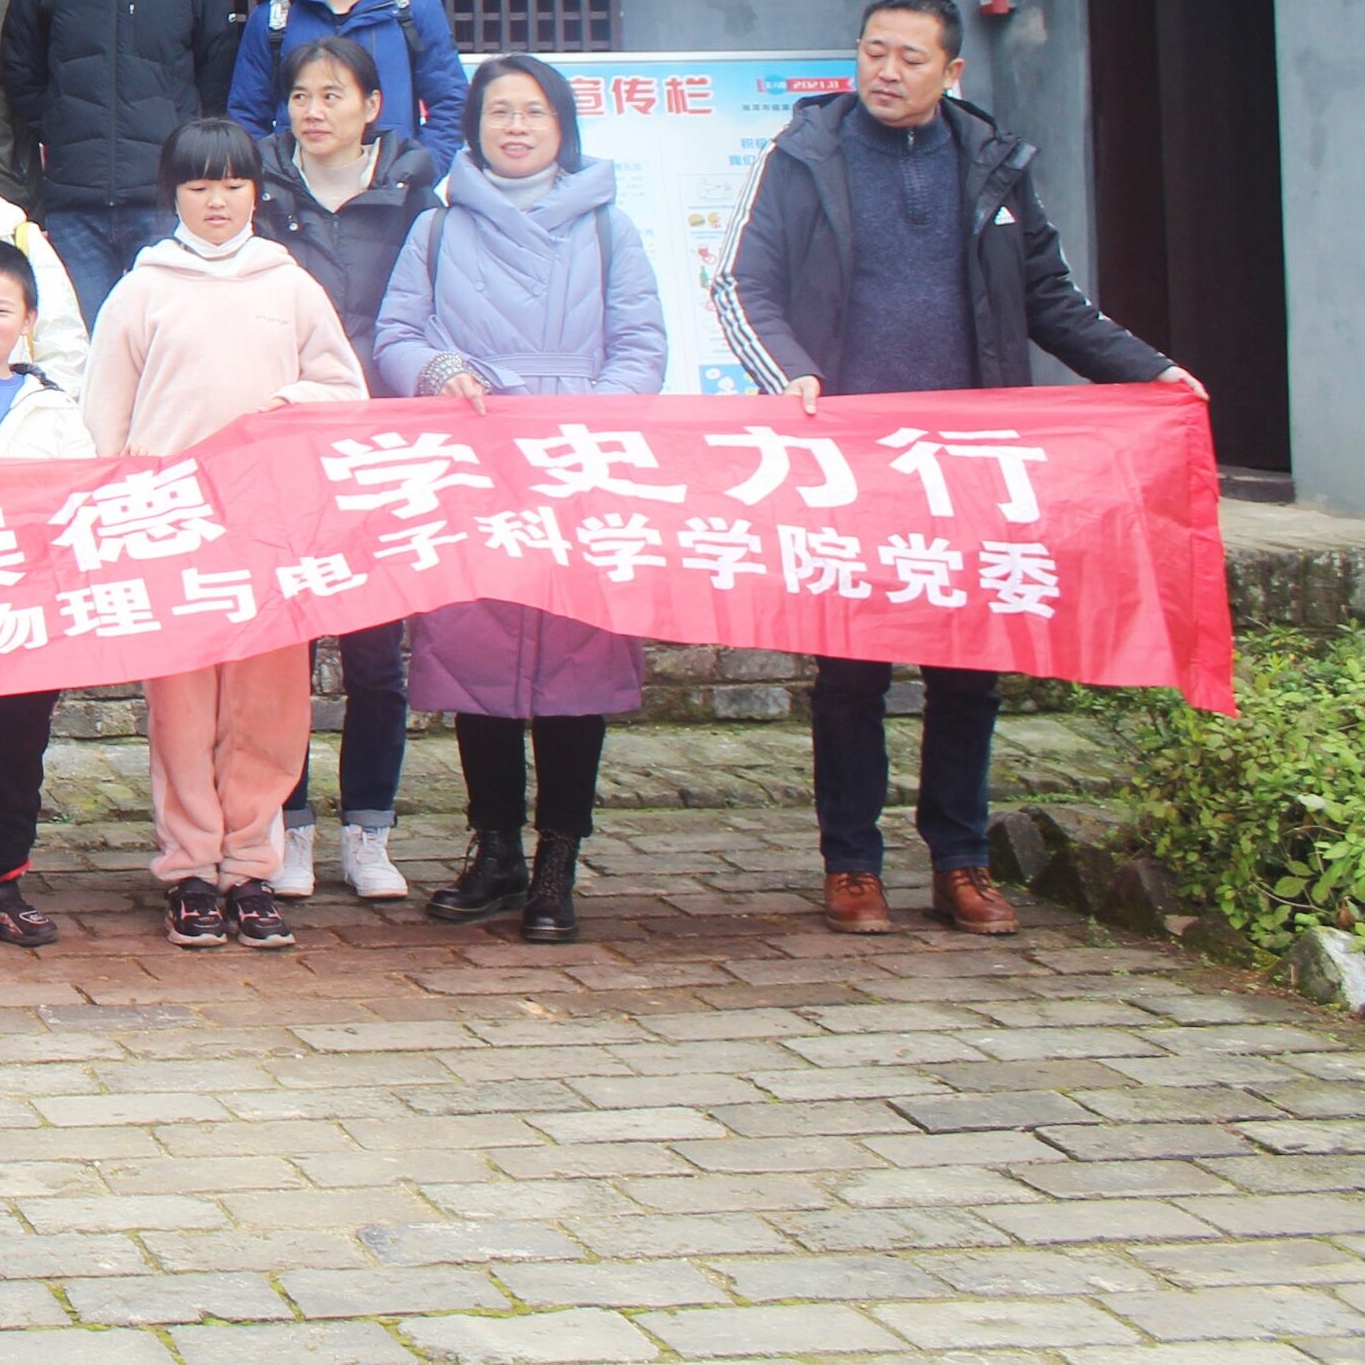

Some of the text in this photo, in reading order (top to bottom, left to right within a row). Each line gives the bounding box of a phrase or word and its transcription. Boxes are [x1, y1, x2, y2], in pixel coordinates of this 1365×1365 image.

[571, 77, 712, 115] 宣传栏
[320, 423, 1048, 524] 学史力行
